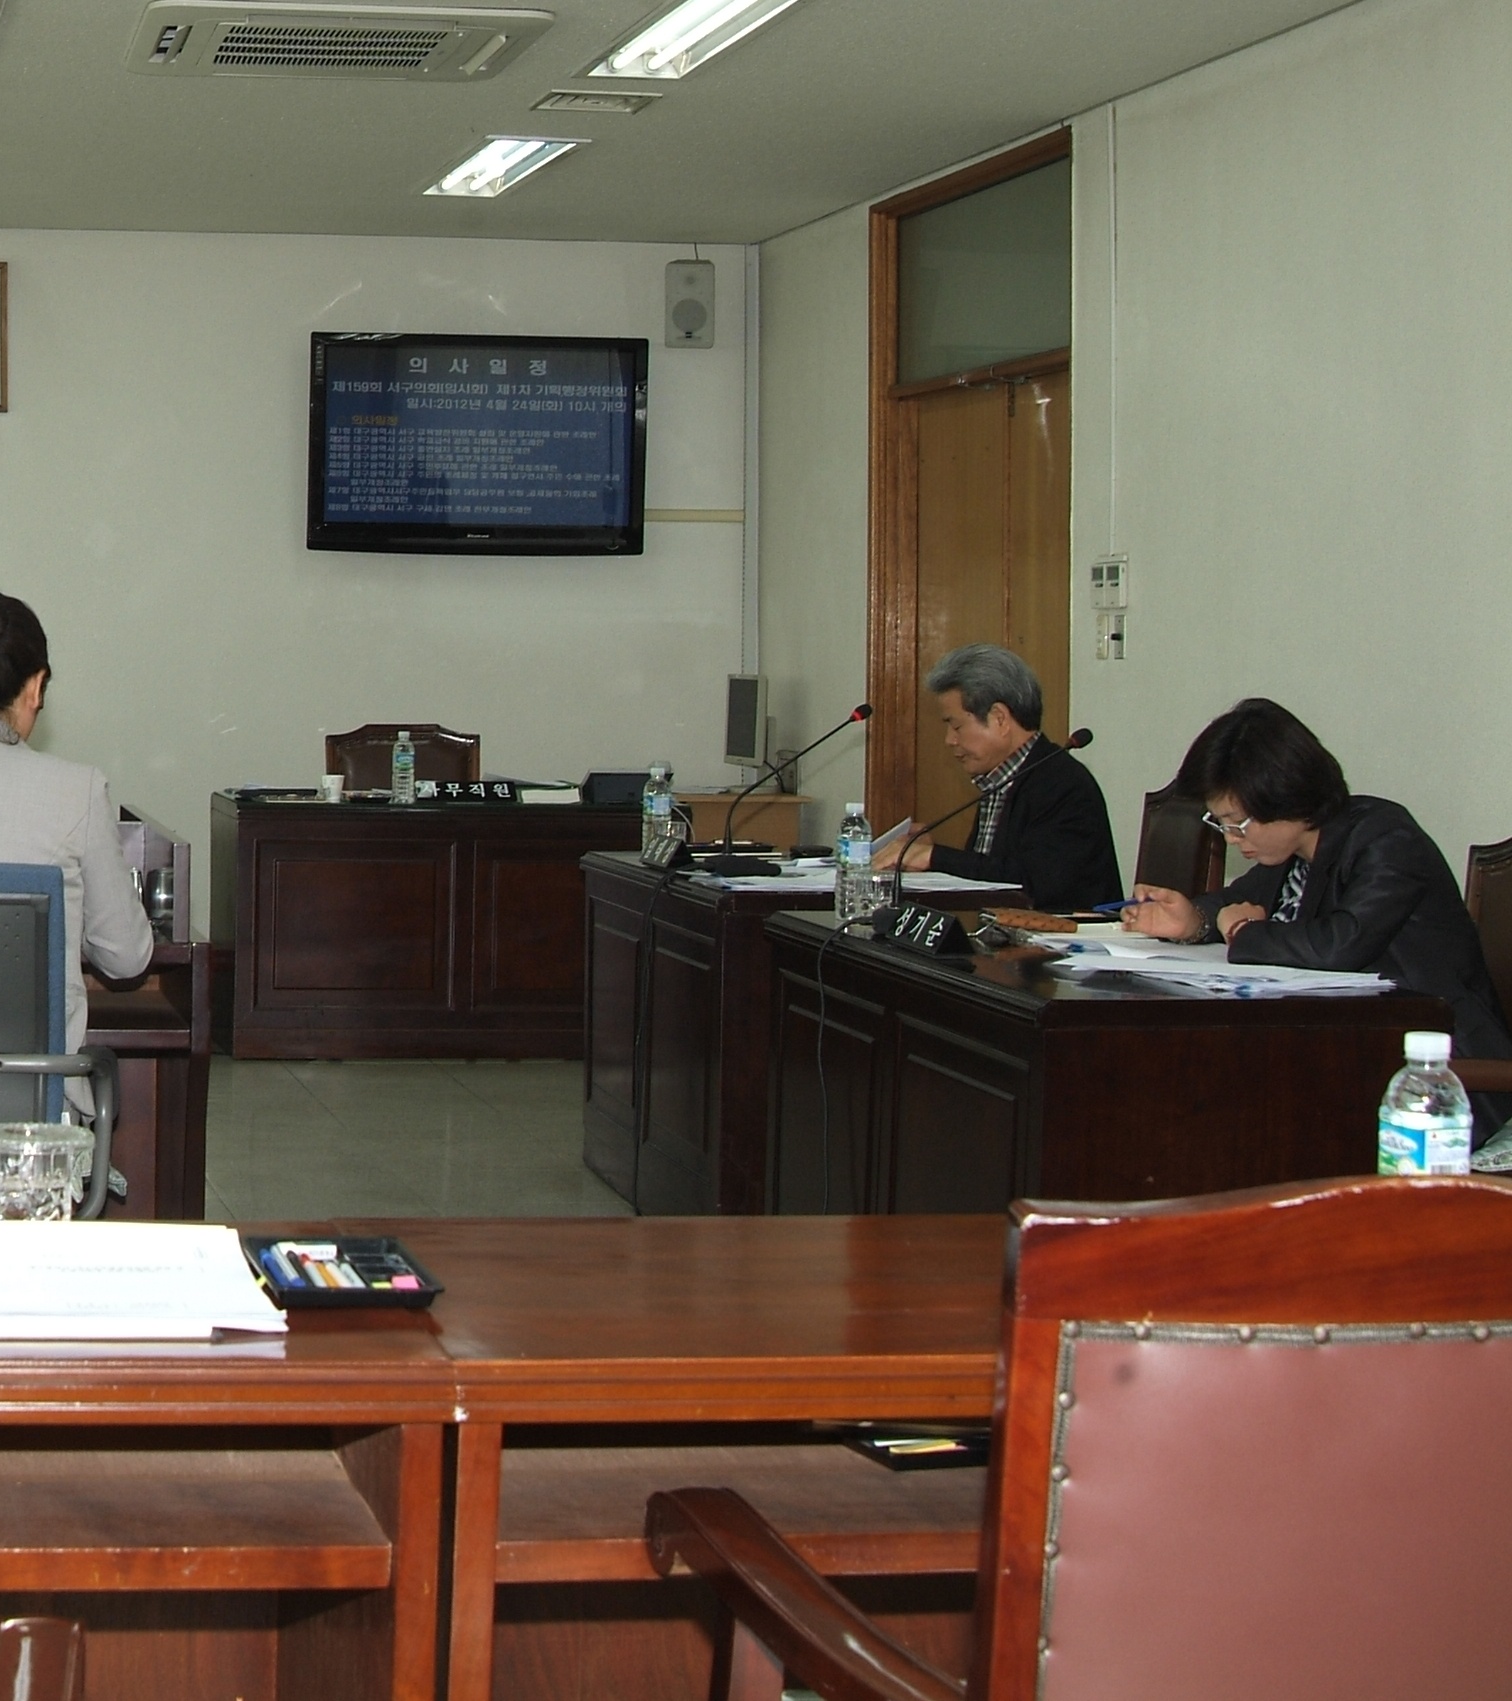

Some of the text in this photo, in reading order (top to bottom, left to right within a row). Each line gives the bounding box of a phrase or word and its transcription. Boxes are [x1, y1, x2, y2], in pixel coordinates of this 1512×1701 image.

[331, 380, 383, 394] 제159회
[496, 383, 531, 396] 제1차
[406, 397, 627, 414] 일시:2012년 4월 24일(화) 10시 개의
[894, 906, 945, 947] 성기순
